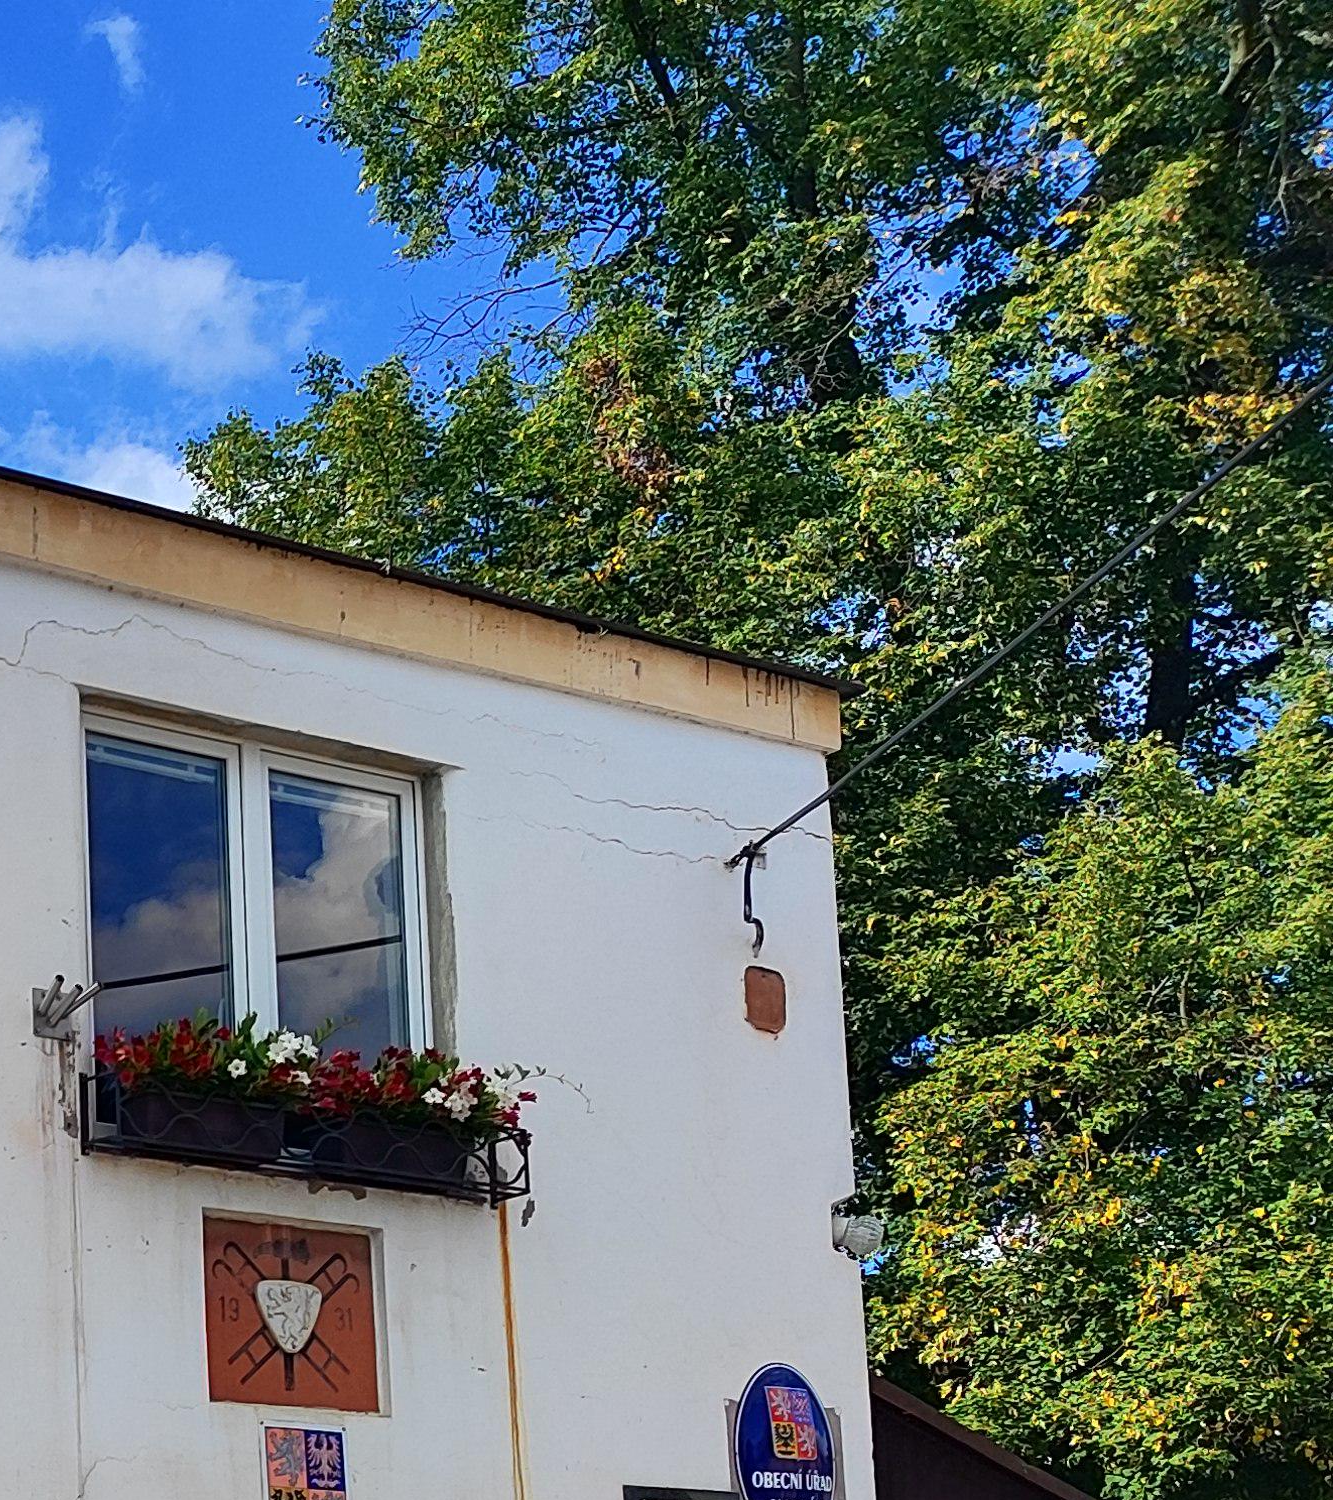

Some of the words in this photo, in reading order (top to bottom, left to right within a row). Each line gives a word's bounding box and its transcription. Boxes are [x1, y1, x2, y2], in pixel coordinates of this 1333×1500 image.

[218, 1295, 240, 1322] 19
[334, 1307, 354, 1332] 31
[752, 1469, 803, 1490] OBECNÍ
[805, 1469, 833, 1493] ÚŘAD
